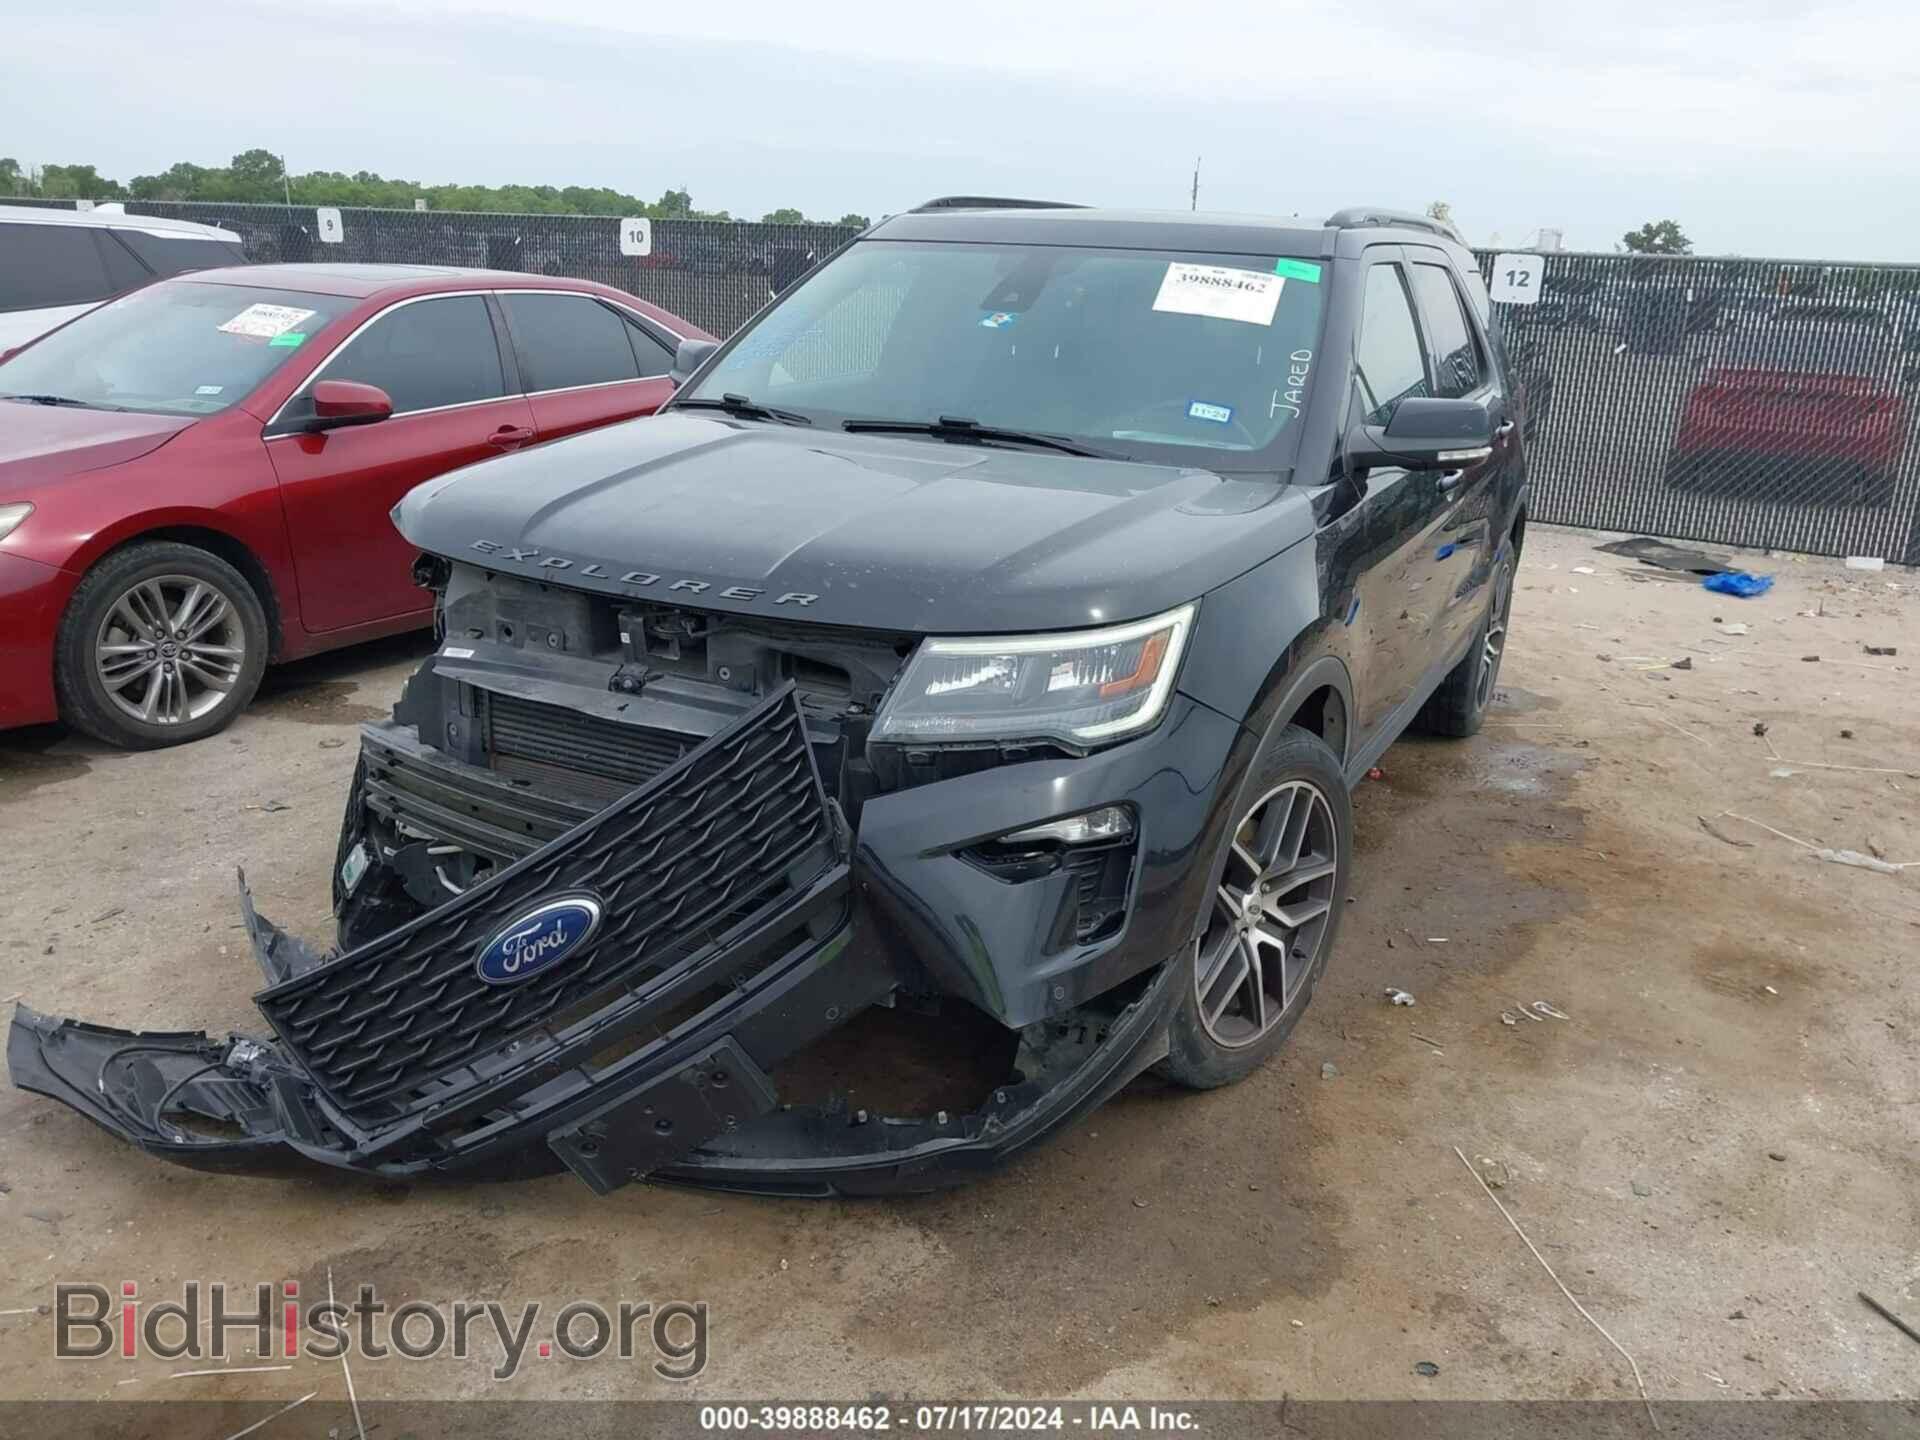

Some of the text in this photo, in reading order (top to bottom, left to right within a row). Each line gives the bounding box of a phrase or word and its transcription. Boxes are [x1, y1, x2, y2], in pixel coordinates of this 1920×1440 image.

[327, 219, 333, 231] 9
[629, 230, 644, 243] 10
[1180, 272, 1267, 293] 39888462
[1506, 270, 1530, 287] 12
[1270, 349, 1312, 418] JARED
[470, 539, 819, 607] EXPLORER
[502, 919, 567, 972] Ford
